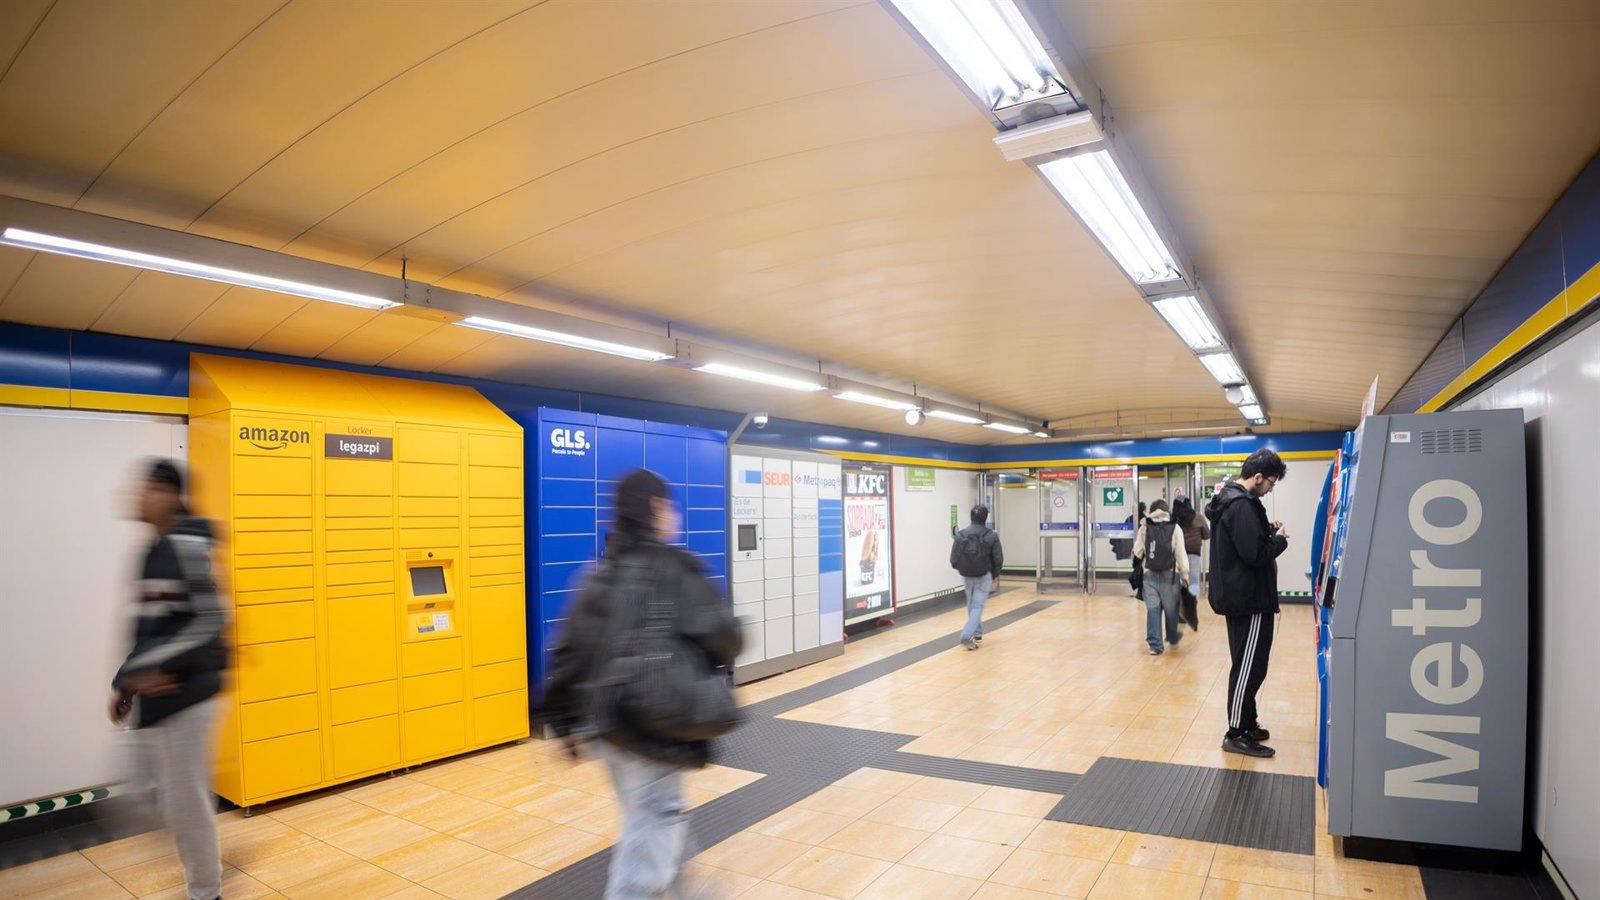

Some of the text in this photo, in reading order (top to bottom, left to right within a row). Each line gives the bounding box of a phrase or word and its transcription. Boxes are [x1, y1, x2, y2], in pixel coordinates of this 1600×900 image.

[239, 426, 310, 444] amazon
[347, 425, 373, 435] Locker
[339, 440, 380, 455] legazpi
[764, 471, 790, 486] SEUR
[858, 474, 885, 494] KFC
[1384, 479, 1484, 804] Metro
